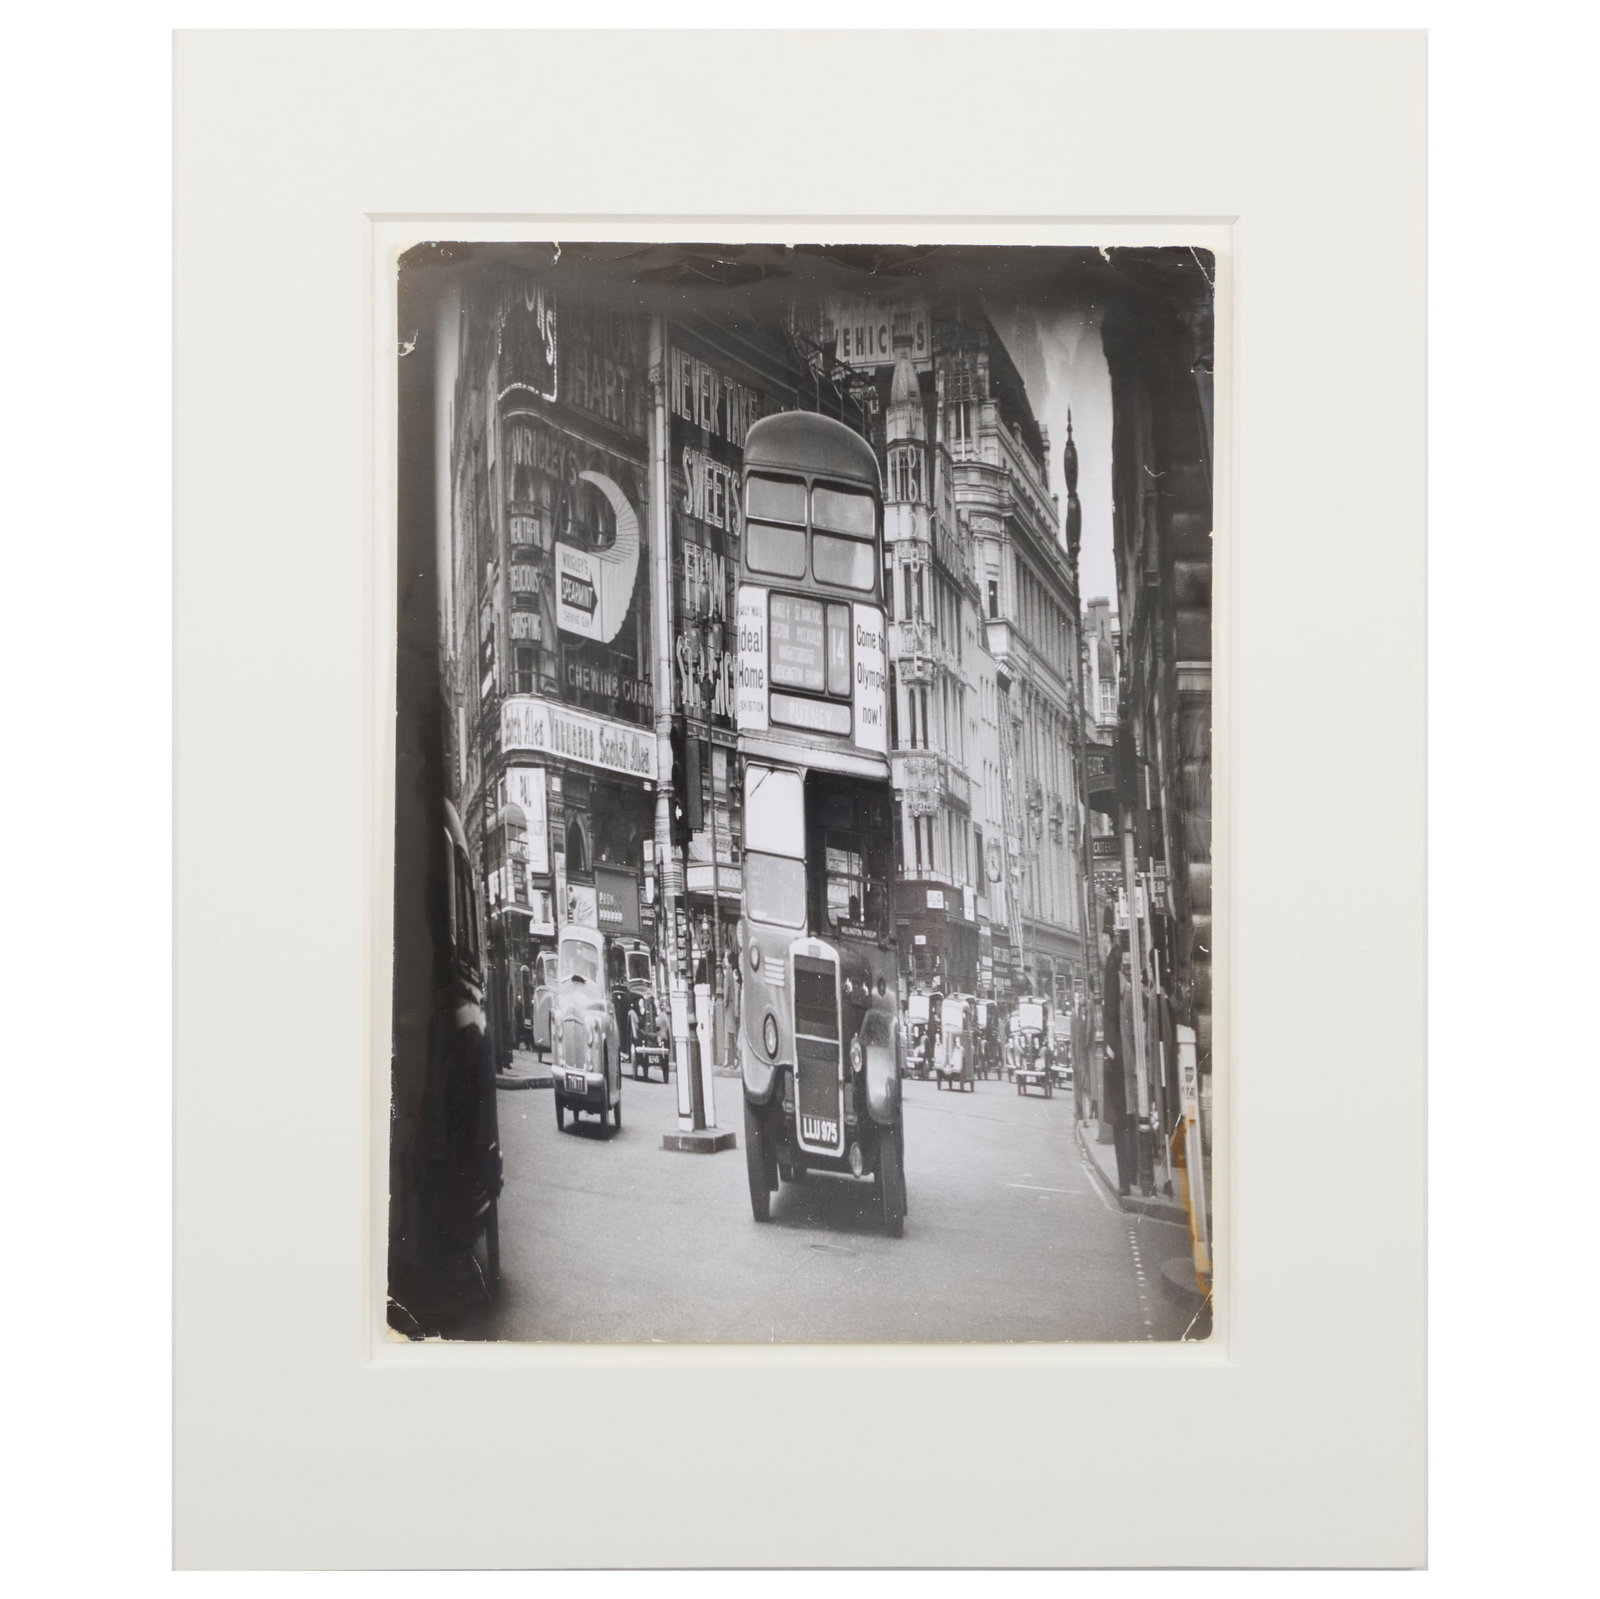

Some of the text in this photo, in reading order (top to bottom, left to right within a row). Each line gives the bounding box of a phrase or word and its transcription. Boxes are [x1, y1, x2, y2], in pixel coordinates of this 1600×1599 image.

[834, 322, 925, 358] EHICS
[671, 346, 721, 437] NEVER
[682, 446, 742, 536] SWEETS
[738, 623, 763, 654] Ideal
[832, 627, 846, 667] 14
[857, 623, 876, 650] Come
[568, 663, 619, 699] CHEWING
[739, 659, 764, 690] Home
[857, 661, 885, 693] Olympia
[789, 701, 833, 730] PUTNEY
[803, 1116, 838, 1143] LLU 975
